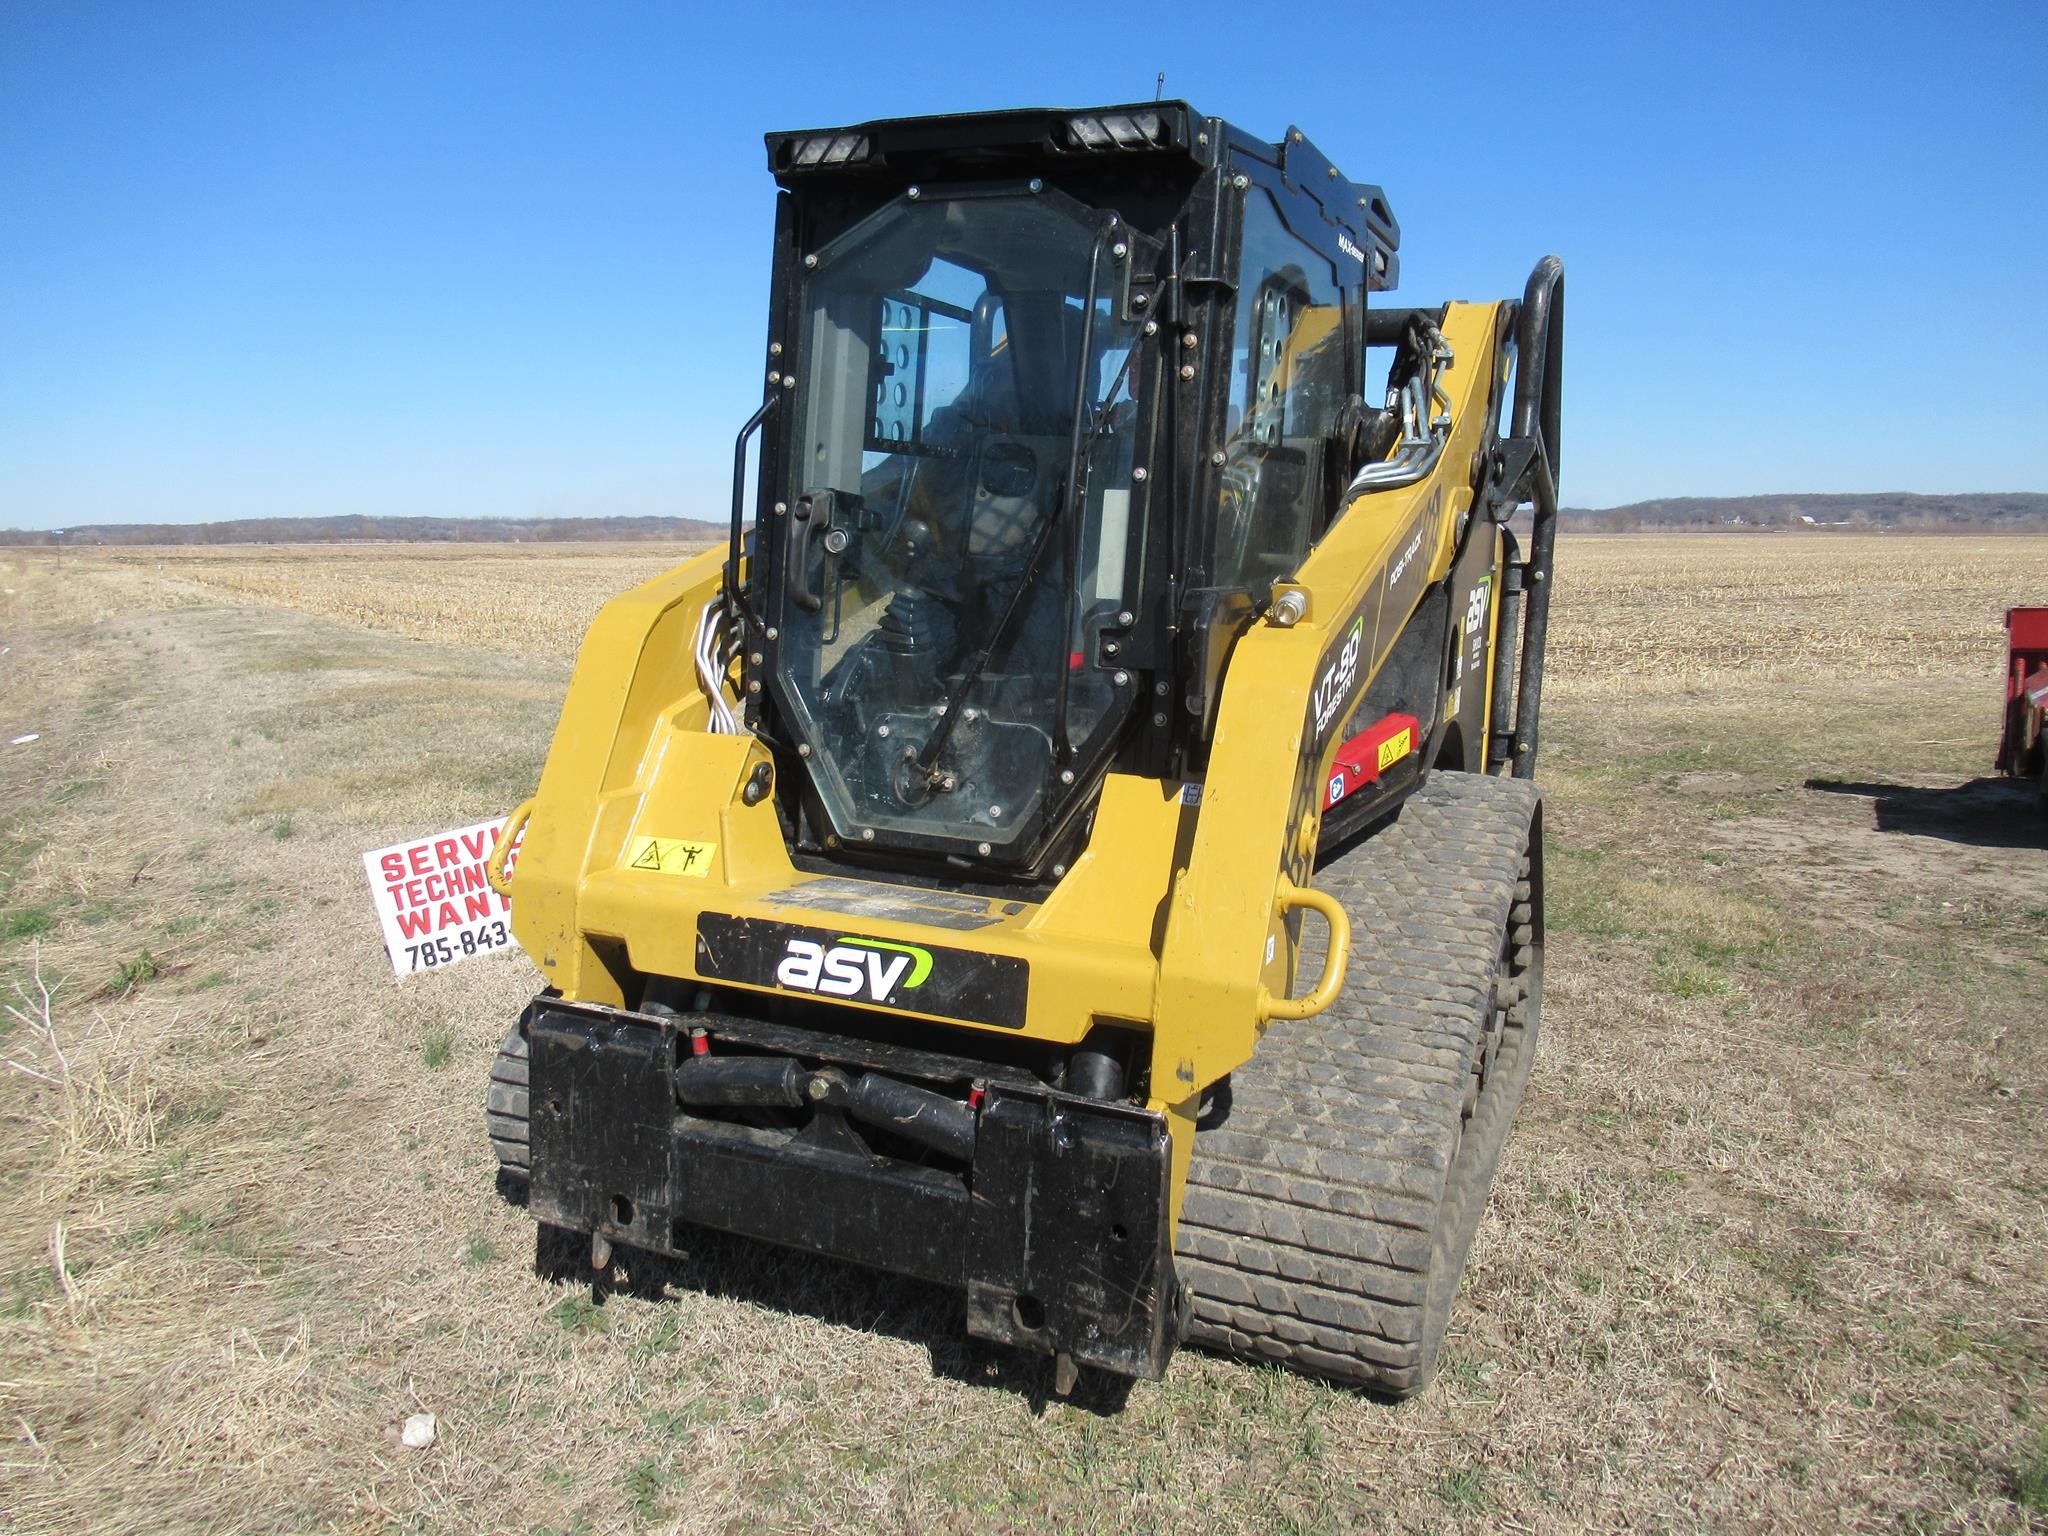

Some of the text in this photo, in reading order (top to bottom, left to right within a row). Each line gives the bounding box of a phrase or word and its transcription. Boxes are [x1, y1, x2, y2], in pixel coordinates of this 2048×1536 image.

[1315, 629, 1359, 720] VT-80
[1316, 663, 1357, 740] FORESTRY
[380, 823, 525, 882] SERVI
[387, 853, 517, 911] TECHN
[405, 921, 511, 971] 785-843
